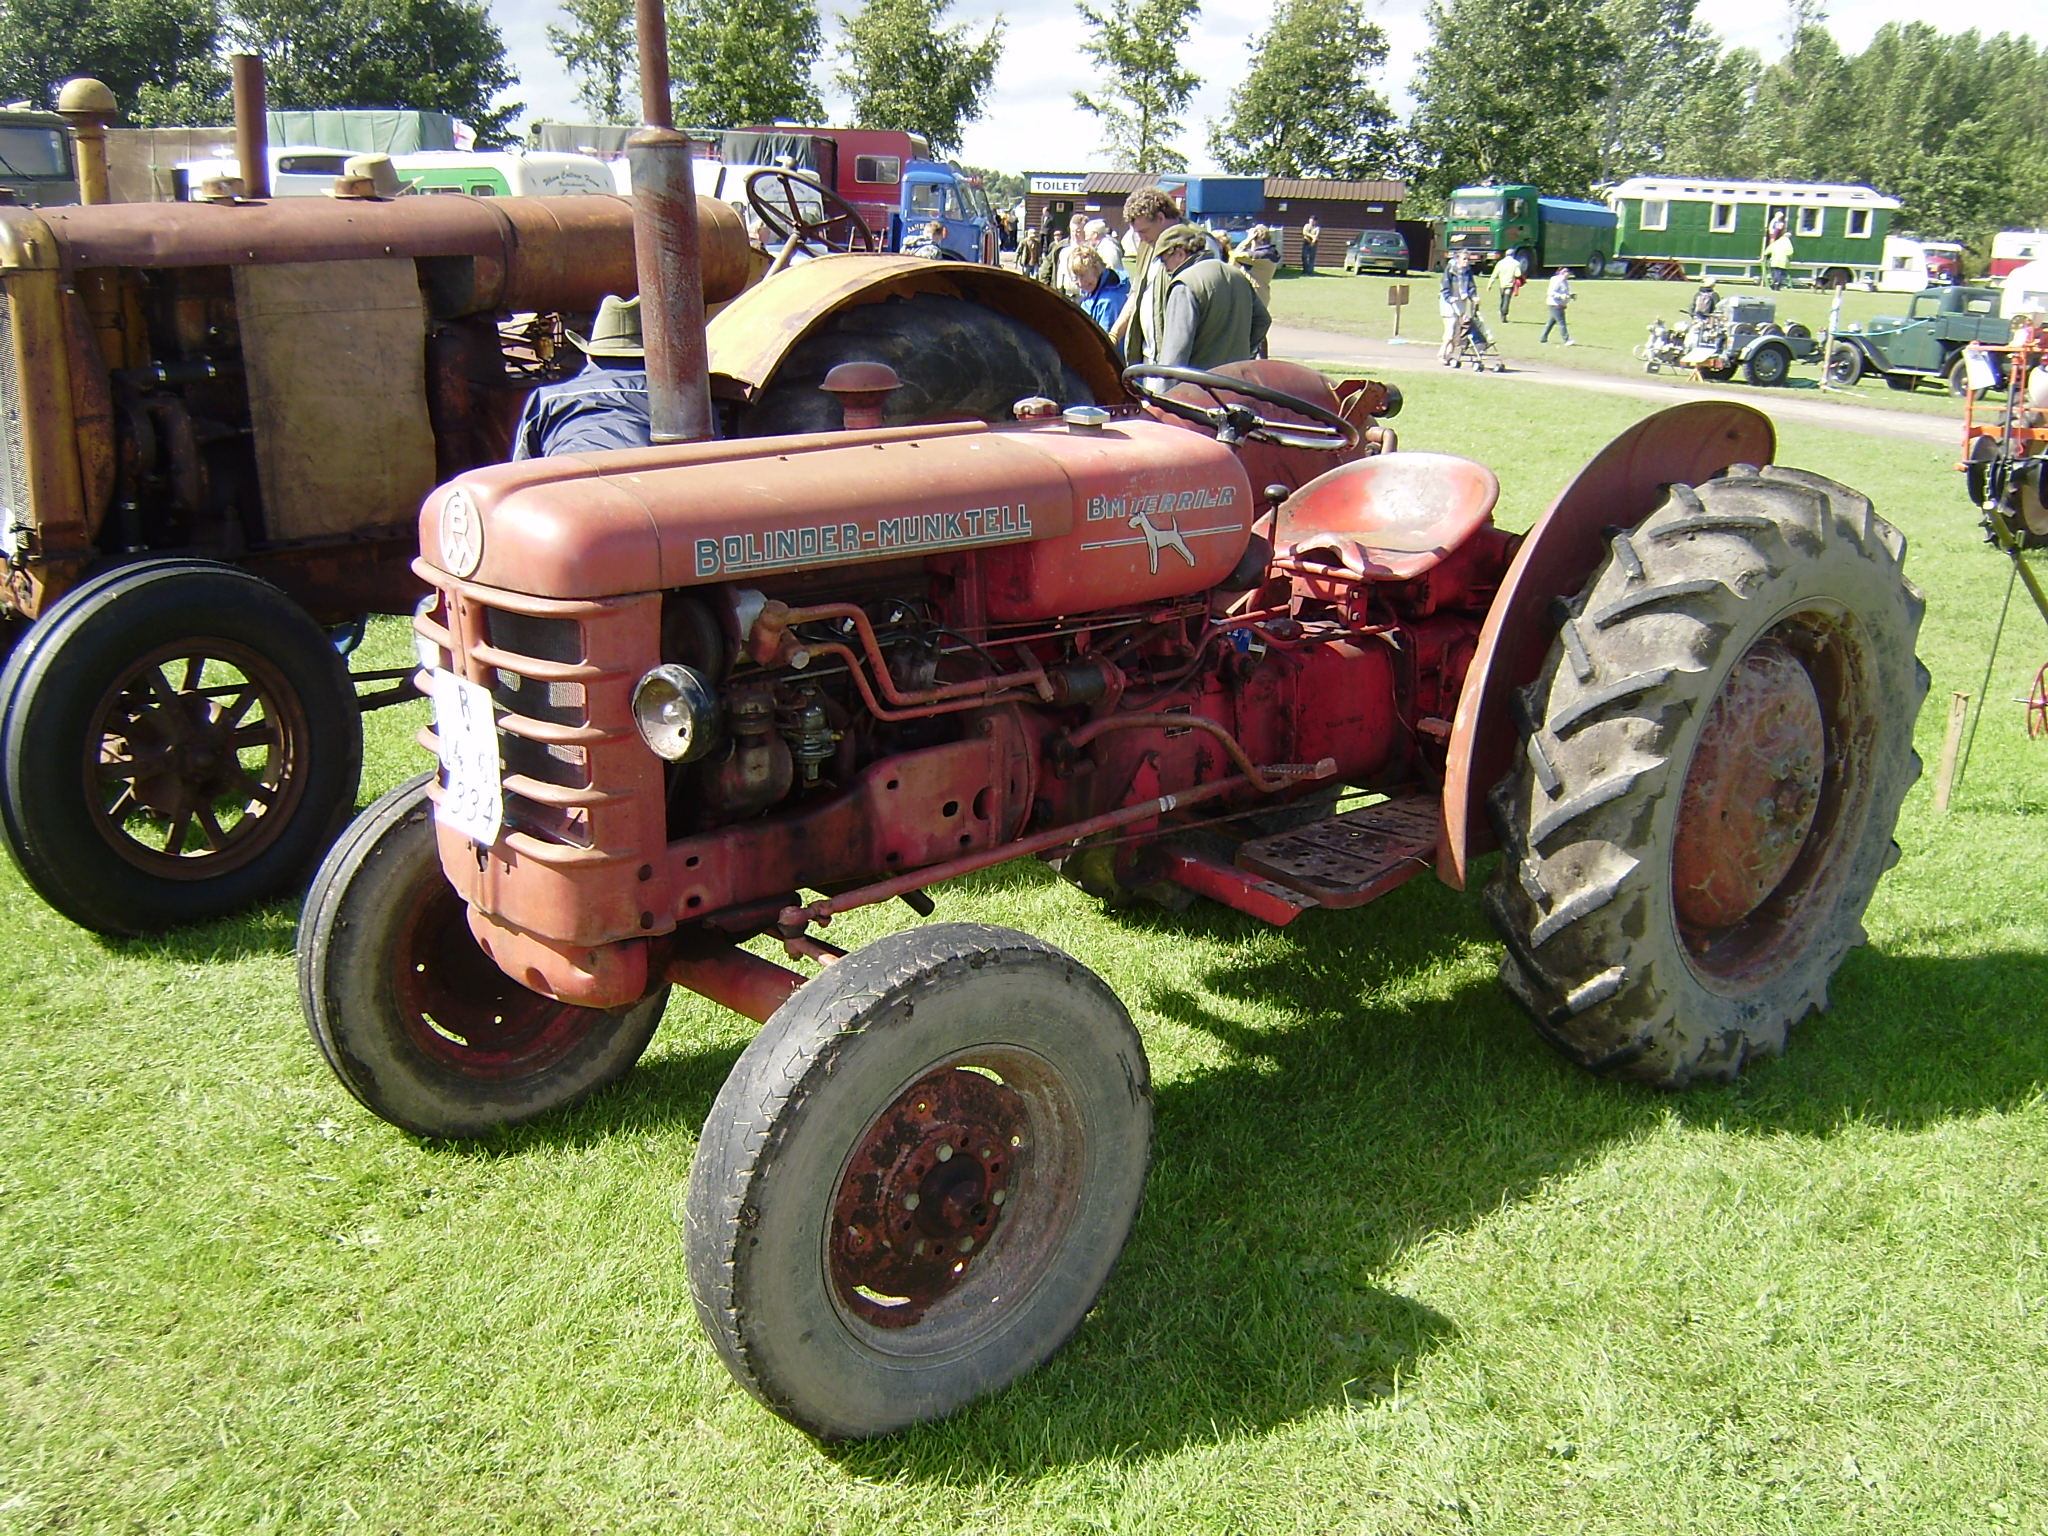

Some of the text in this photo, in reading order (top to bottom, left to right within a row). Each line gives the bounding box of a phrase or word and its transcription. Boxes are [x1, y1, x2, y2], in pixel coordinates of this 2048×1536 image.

[1087, 487, 1236, 521] BM TERRIER
[694, 504, 1033, 577] BOLINDER-MUNKTELL
